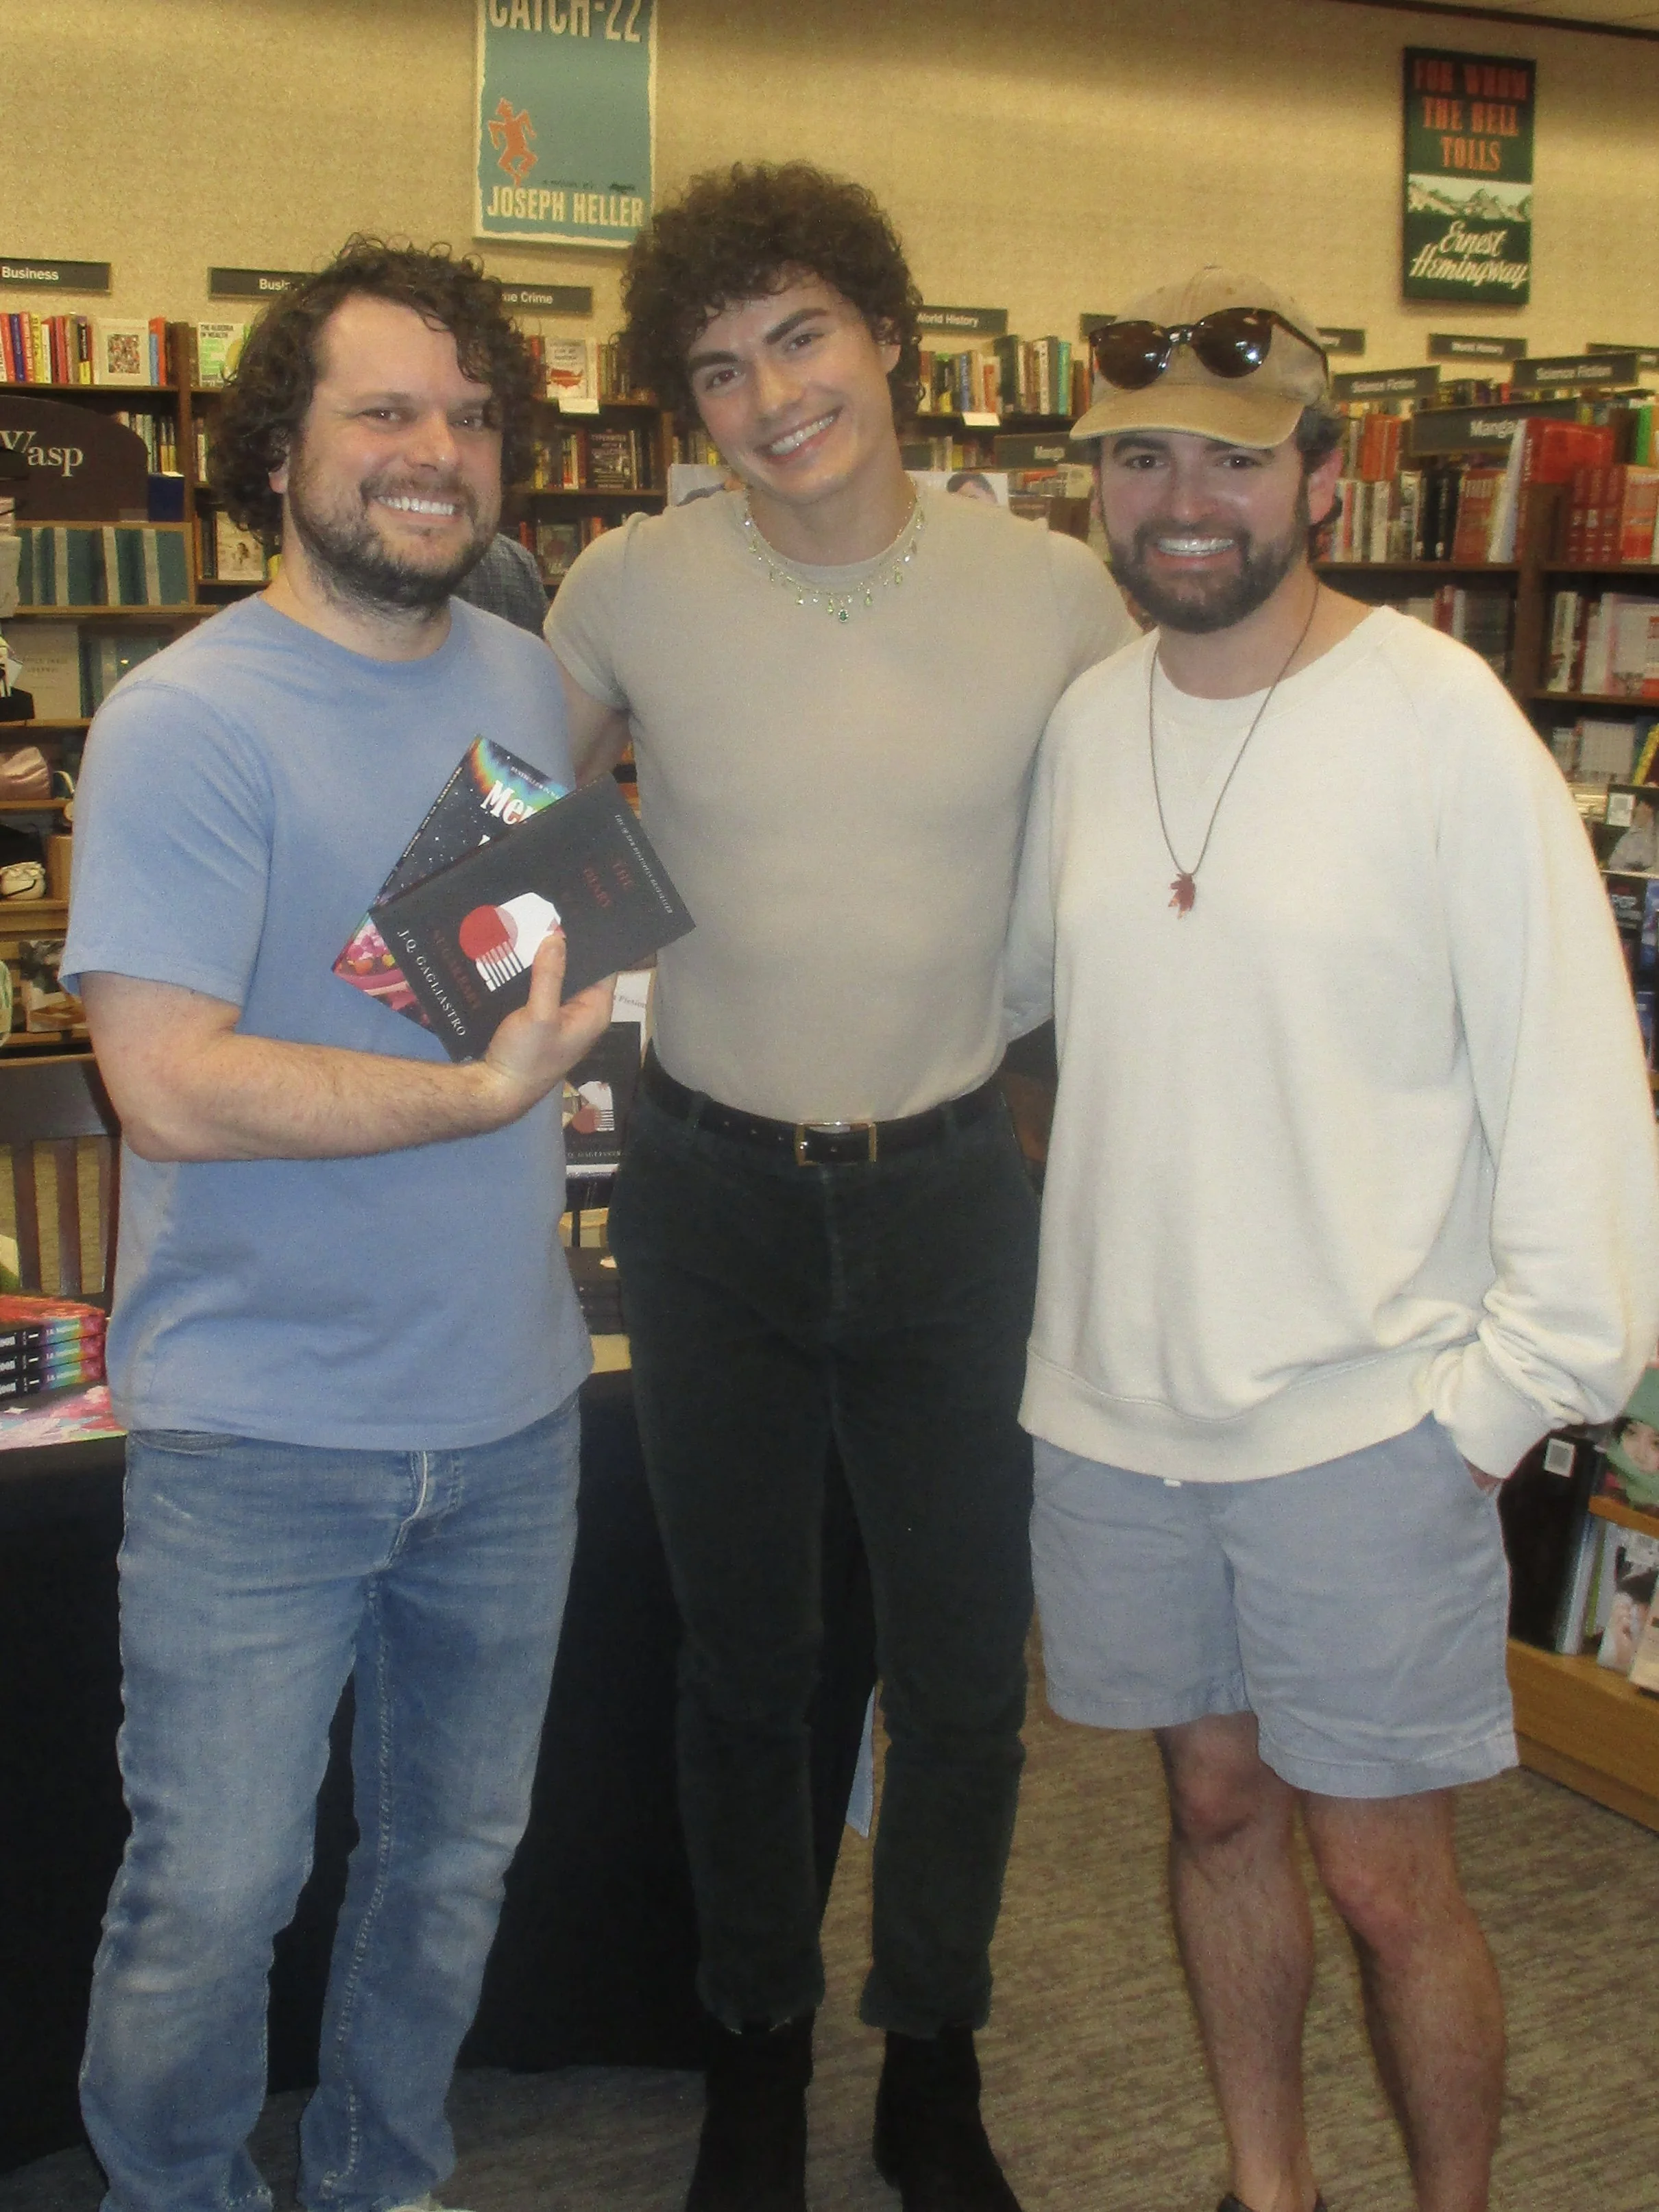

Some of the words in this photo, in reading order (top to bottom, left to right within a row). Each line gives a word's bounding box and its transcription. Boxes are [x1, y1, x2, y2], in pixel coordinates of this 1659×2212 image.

[487, 0, 642, 42] CATCH-22
[1440, 135, 1501, 172] TOLLS
[486, 185, 566, 223] JOSEPH
[573, 191, 644, 227] HELLER
[1440, 220, 1507, 258] Ernest
[1, 265, 60, 281] Business
[1409, 243, 1529, 291] Hemingway
[521, 290, 554, 304] Crime
[416, 956, 467, 1036] GAGLIASTRO
